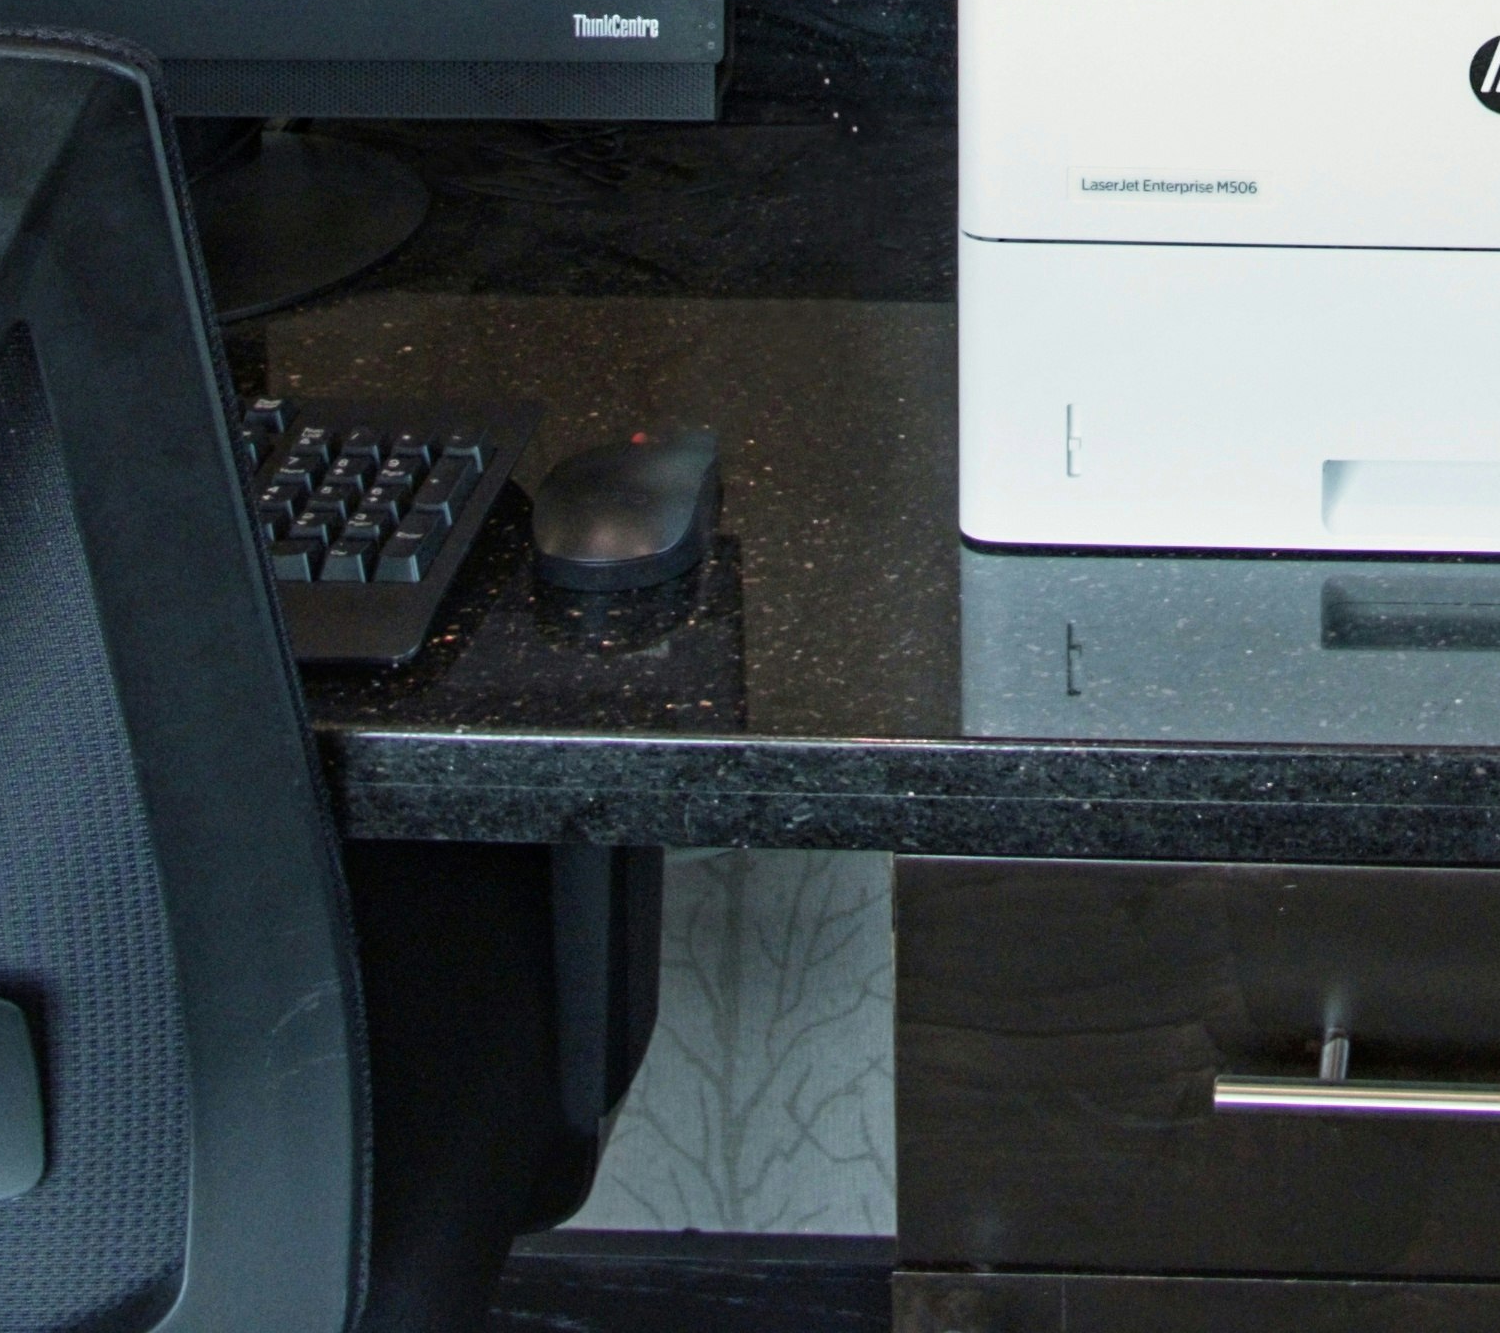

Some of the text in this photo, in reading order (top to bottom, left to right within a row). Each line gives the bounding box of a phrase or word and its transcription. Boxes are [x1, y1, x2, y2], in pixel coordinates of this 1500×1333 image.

[572, 13, 659, 38] ThinkCentre
[1080, 178, 1258, 195] LaserJet Enterprise M506
